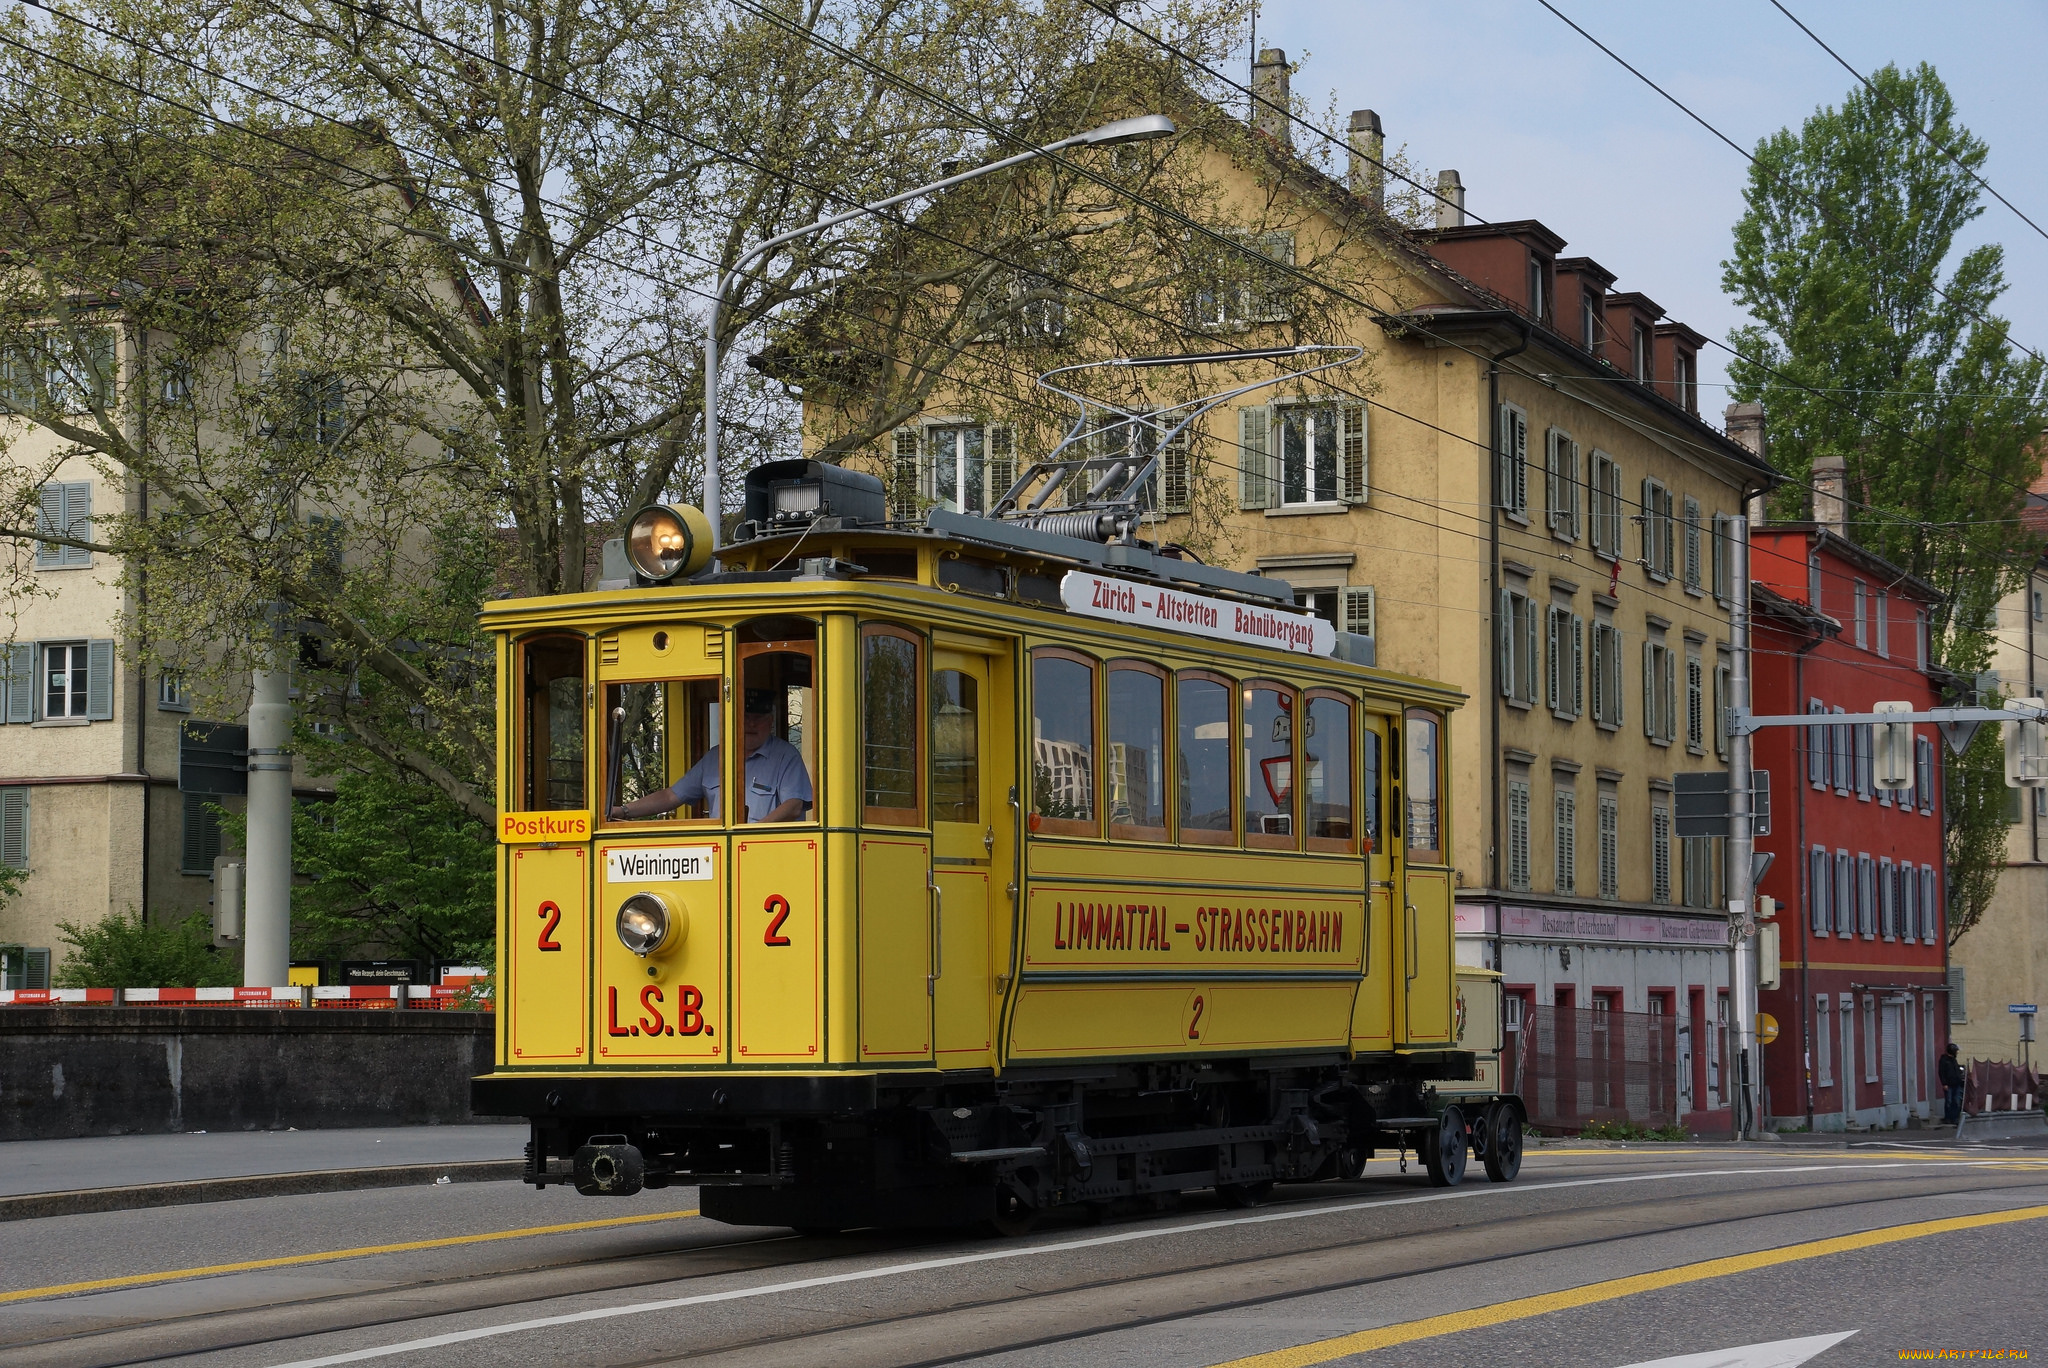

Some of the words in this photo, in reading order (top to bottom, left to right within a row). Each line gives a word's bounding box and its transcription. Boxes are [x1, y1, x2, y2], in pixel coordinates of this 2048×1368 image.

[1092, 579, 1135, 614] Zürich
[1156, 592, 1217, 628] Altstetten
[1235, 607, 1314, 653] Bahnübergang
[504, 815, 586, 836] Postkurs
[619, 853, 699, 879] Weiningen
[537, 900, 561, 952] 2
[763, 894, 790, 947] 2
[1542, 914, 1575, 934] Restaurant
[1577, 916, 1617, 936] Güterbahnhof
[1662, 922, 1688, 939] Restaurant
[608, 985, 714, 1037] L.S.B.
[1188, 995, 1204, 1040] 2
